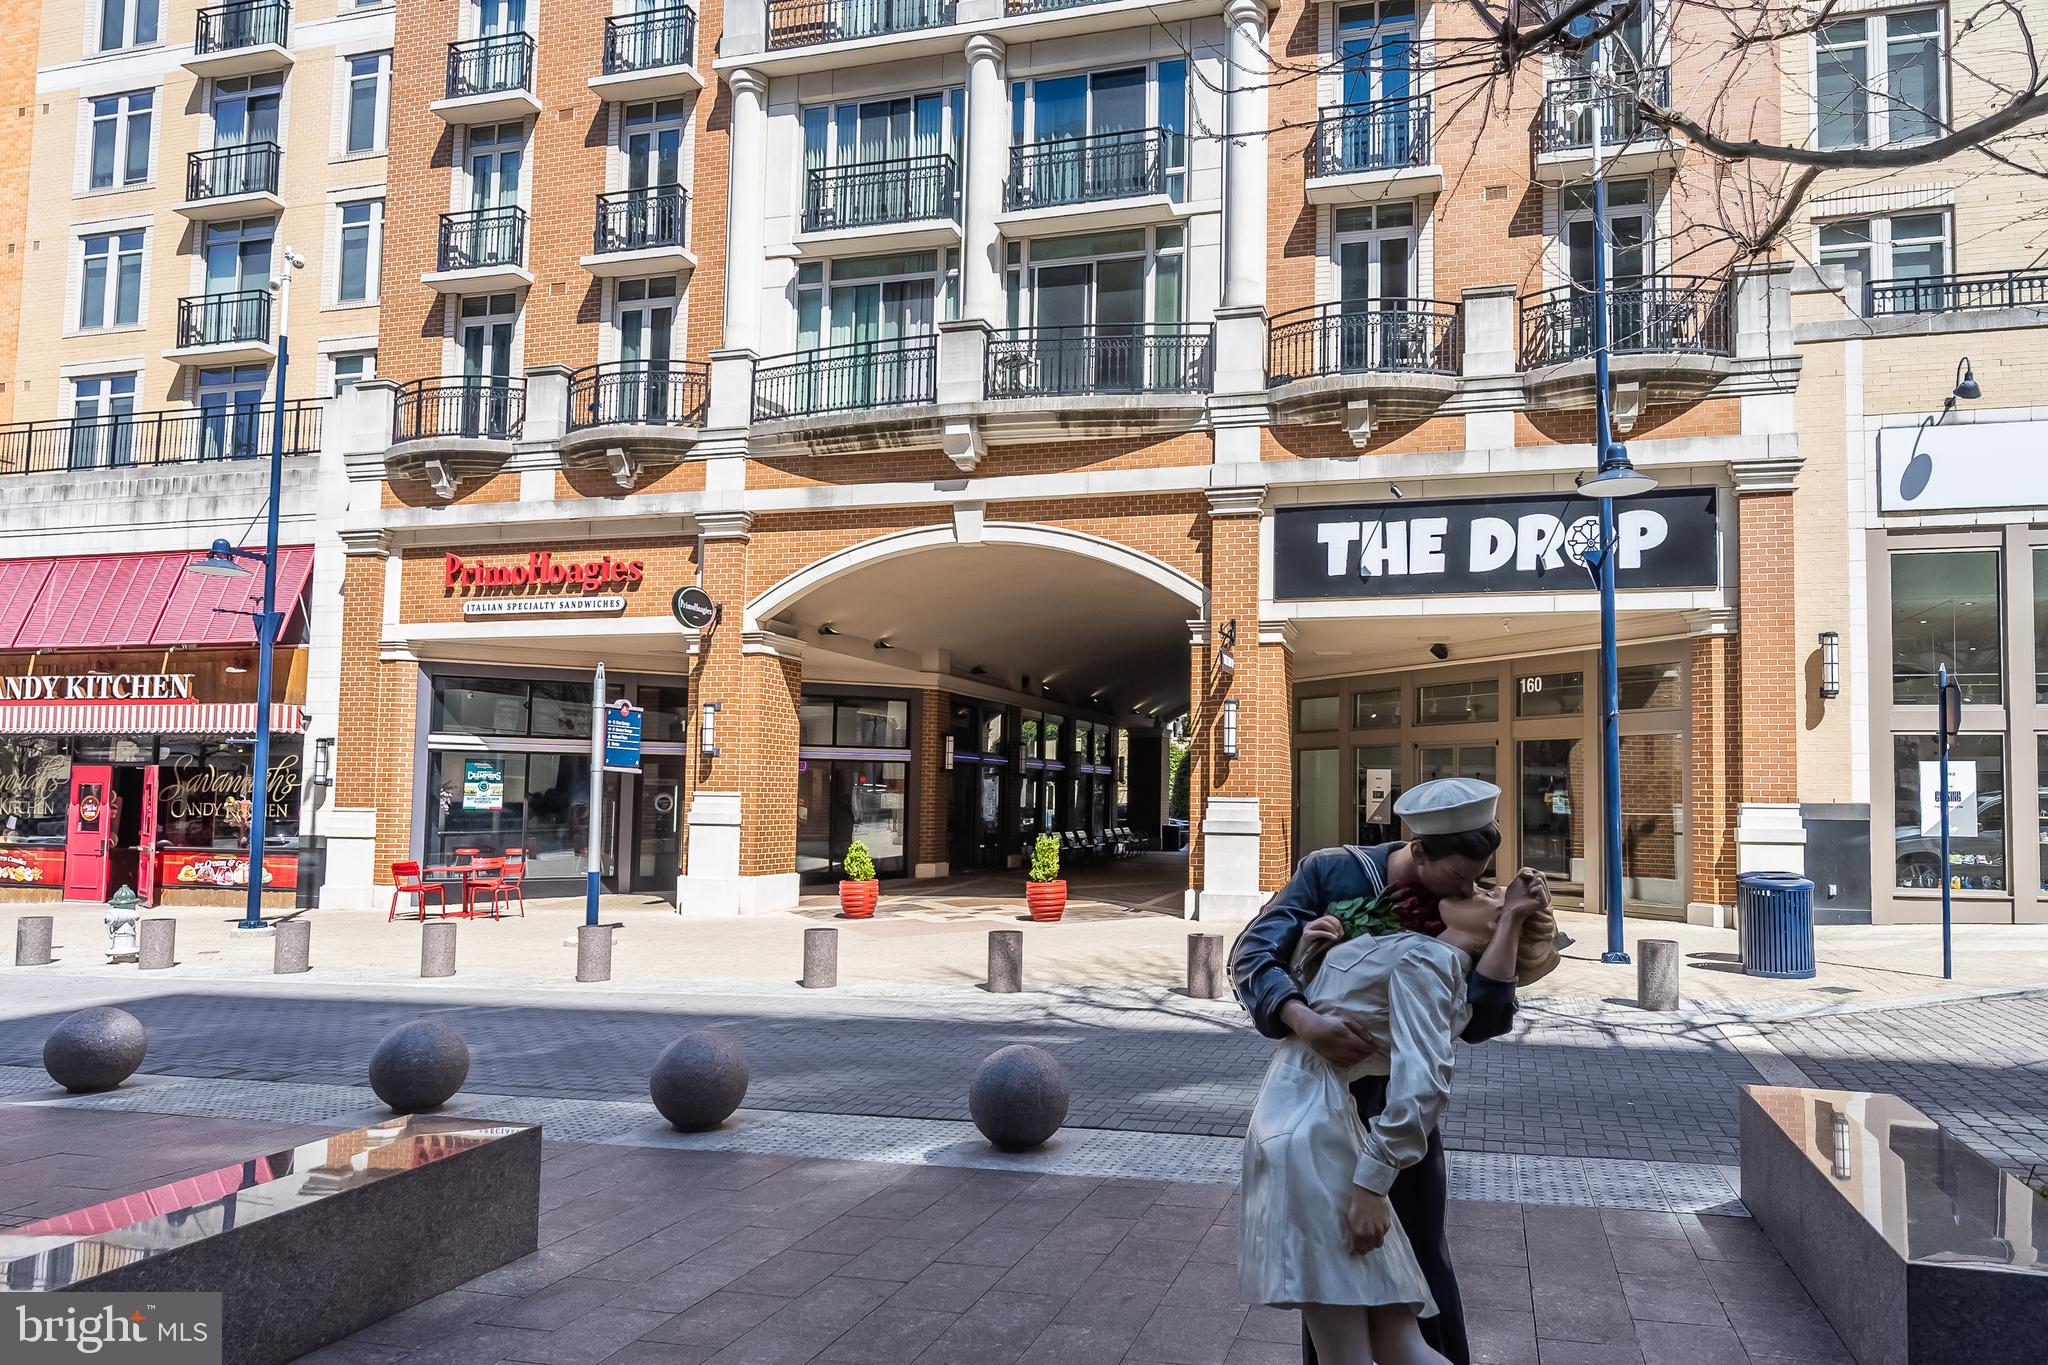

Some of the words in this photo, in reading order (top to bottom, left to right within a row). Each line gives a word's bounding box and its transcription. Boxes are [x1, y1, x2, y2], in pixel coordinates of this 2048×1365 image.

[1317, 517, 1448, 576] THE
[1469, 509, 1669, 572] DROP
[444, 551, 644, 591] PrimoHoagies
[466, 603, 504, 612] ITALIAN
[506, 601, 556, 611] SPECIALTY
[559, 599, 621, 610] SANDWICHES
[0, 676, 60, 699] NDY
[65, 674, 190, 699] KITCHEN
[1520, 677, 1542, 693] 160
[171, 800, 221, 818] CANDY
